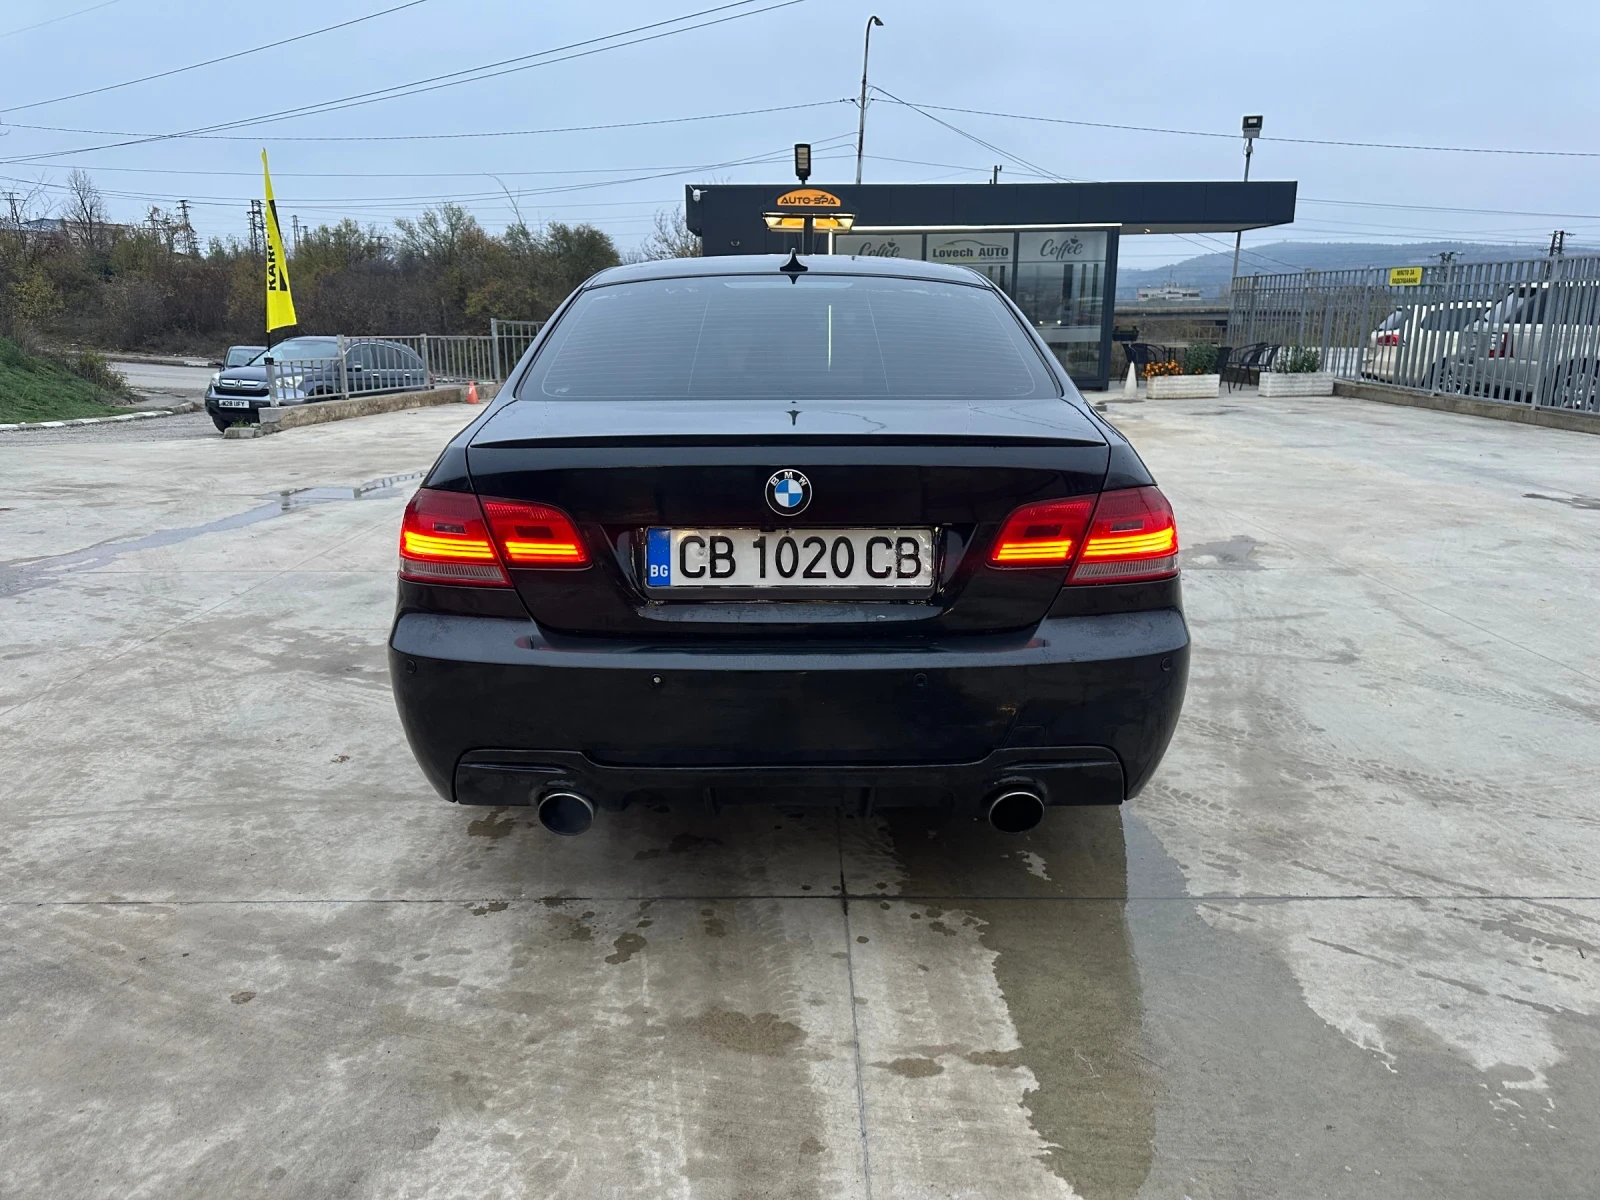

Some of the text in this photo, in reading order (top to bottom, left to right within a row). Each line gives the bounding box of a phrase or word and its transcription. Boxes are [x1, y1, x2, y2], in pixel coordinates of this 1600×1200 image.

[932, 247, 1009, 258] Lovech AUTO
[1040, 238, 1083, 261] Coffee
[770, 471, 808, 487] BMW
[679, 535, 922, 579] CB 1020 CB
[650, 564, 669, 578] BG
